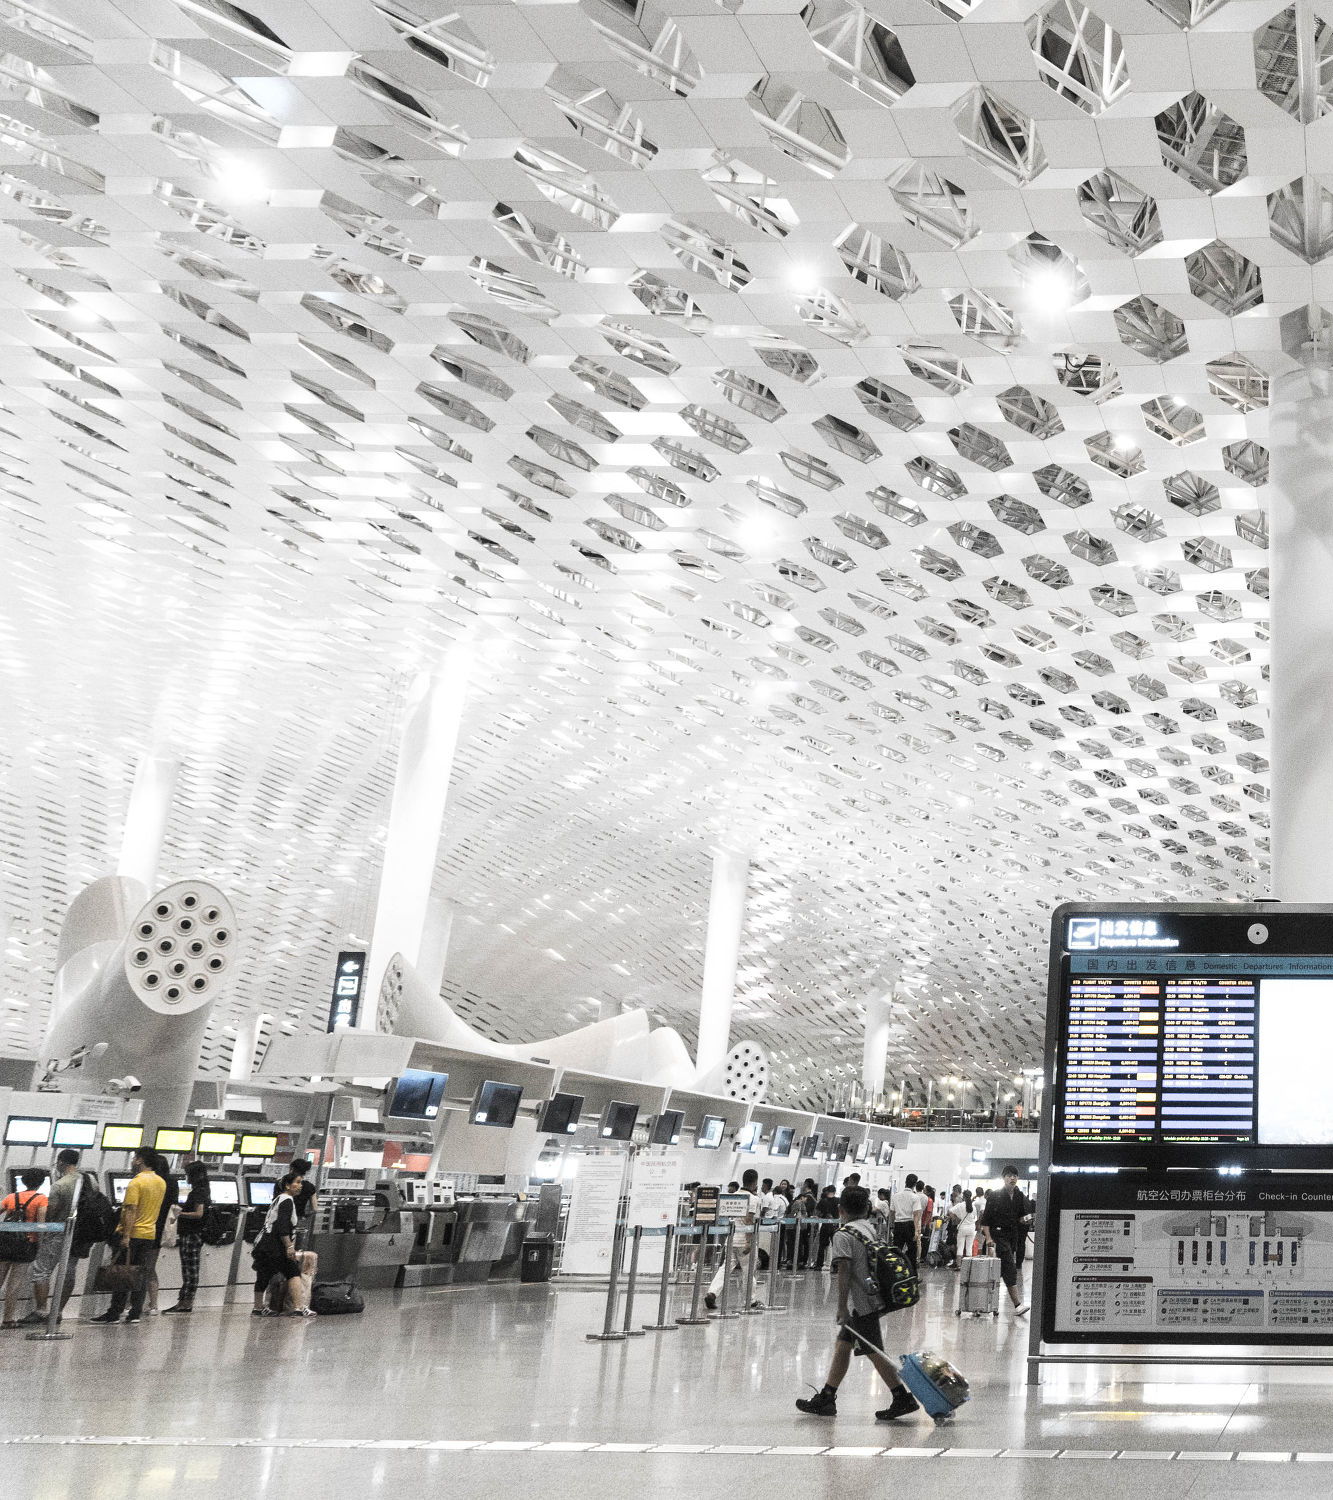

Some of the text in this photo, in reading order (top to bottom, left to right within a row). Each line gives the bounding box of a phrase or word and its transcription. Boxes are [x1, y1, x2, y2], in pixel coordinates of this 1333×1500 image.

[1087, 959, 1197, 971] 国内出发信息
[1203, 962, 1332, 971] Domestic Departures Information
[1137, 1190, 1246, 1201] 航空公司办票柜台分布
[1258, 1192, 1297, 1201] Check-in
[1301, 1193, 1333, 1201] Counter
